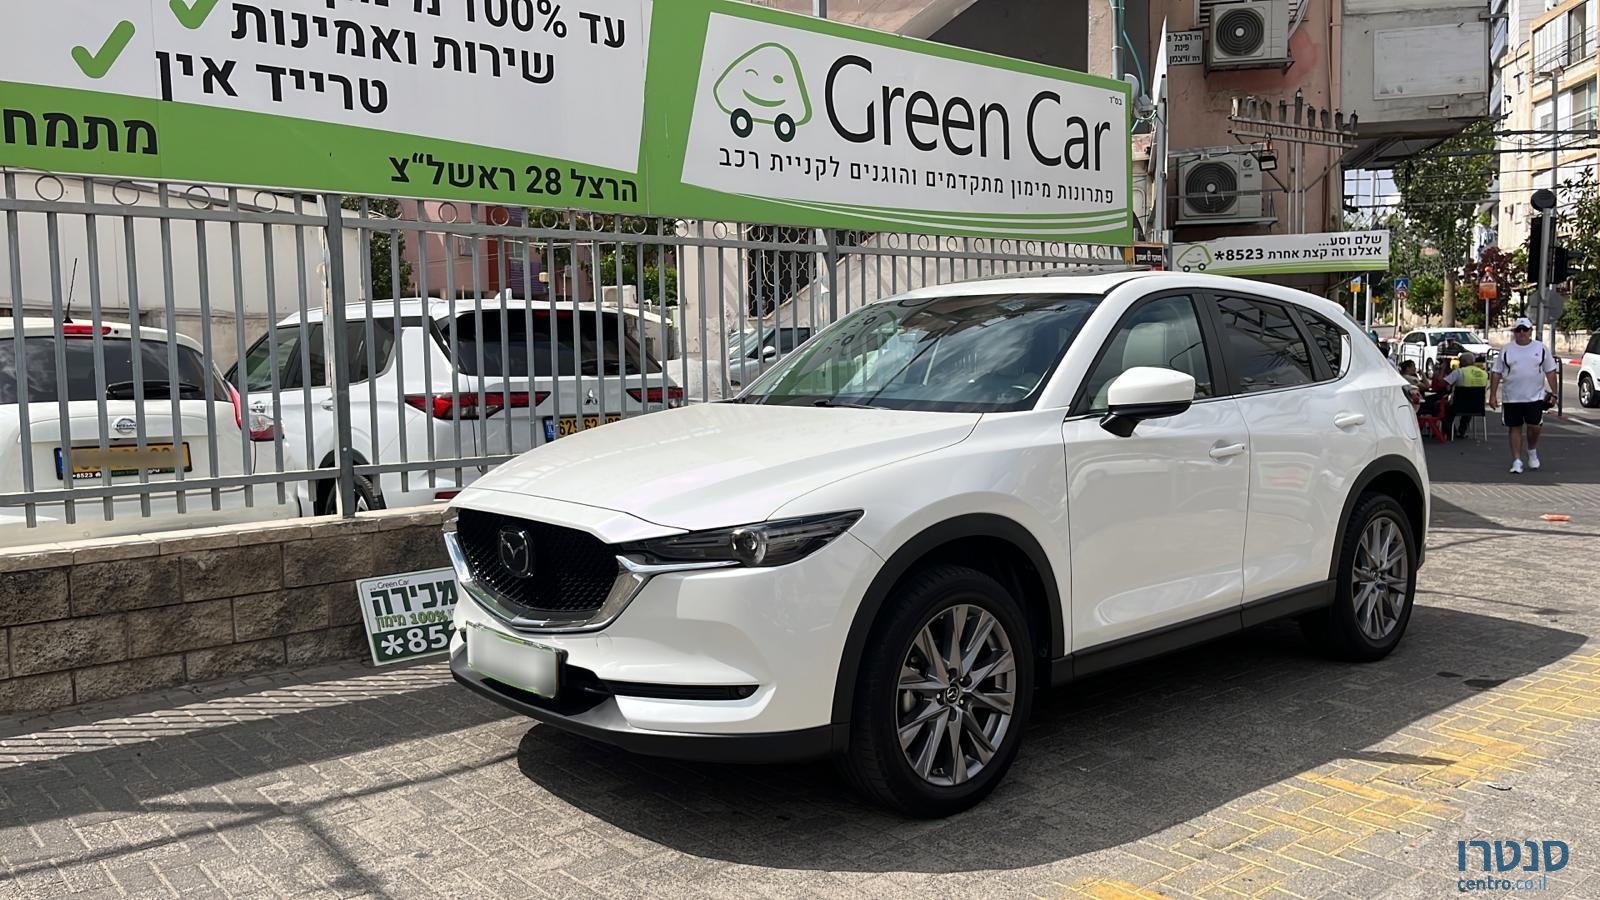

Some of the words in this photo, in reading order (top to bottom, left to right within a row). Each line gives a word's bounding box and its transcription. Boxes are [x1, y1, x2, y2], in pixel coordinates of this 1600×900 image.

[465, 0, 567, 38] 100%
[579, 12, 625, 48] עד
[231, 3, 417, 65] ואמינות
[1173, 33, 1193, 42] הרצל
[433, 35, 554, 84] שירות
[156, 51, 238, 102] אין
[255, 64, 388, 114] טרייד
[824, 54, 1011, 160] Green
[1026, 90, 1111, 172] Car
[719, 147, 760, 170] רכב
[769, 153, 840, 182] לקניית
[388, 152, 516, 192] ראשל"צ
[525, 165, 562, 195] 28
[850, 162, 917, 186] והוגנים
[926, 170, 1004, 196] מתקדמים
[570, 168, 638, 203] הרצל
[1011, 179, 1051, 200] מימון
[1057, 184, 1113, 204] פתרונות
[1318, 236, 1351, 247] וסע...
[1348, 245, 1382, 256] אצלנו
[1355, 234, 1382, 245] שלם
[1267, 249, 1300, 260] אחרת
[1302, 248, 1328, 260] קצת
[1331, 247, 1345, 257] זה
[370, 580, 459, 616] מכירה
[377, 582, 397, 590] Green
[375, 614, 407, 632] מימון
[409, 609, 448, 624] 100%
